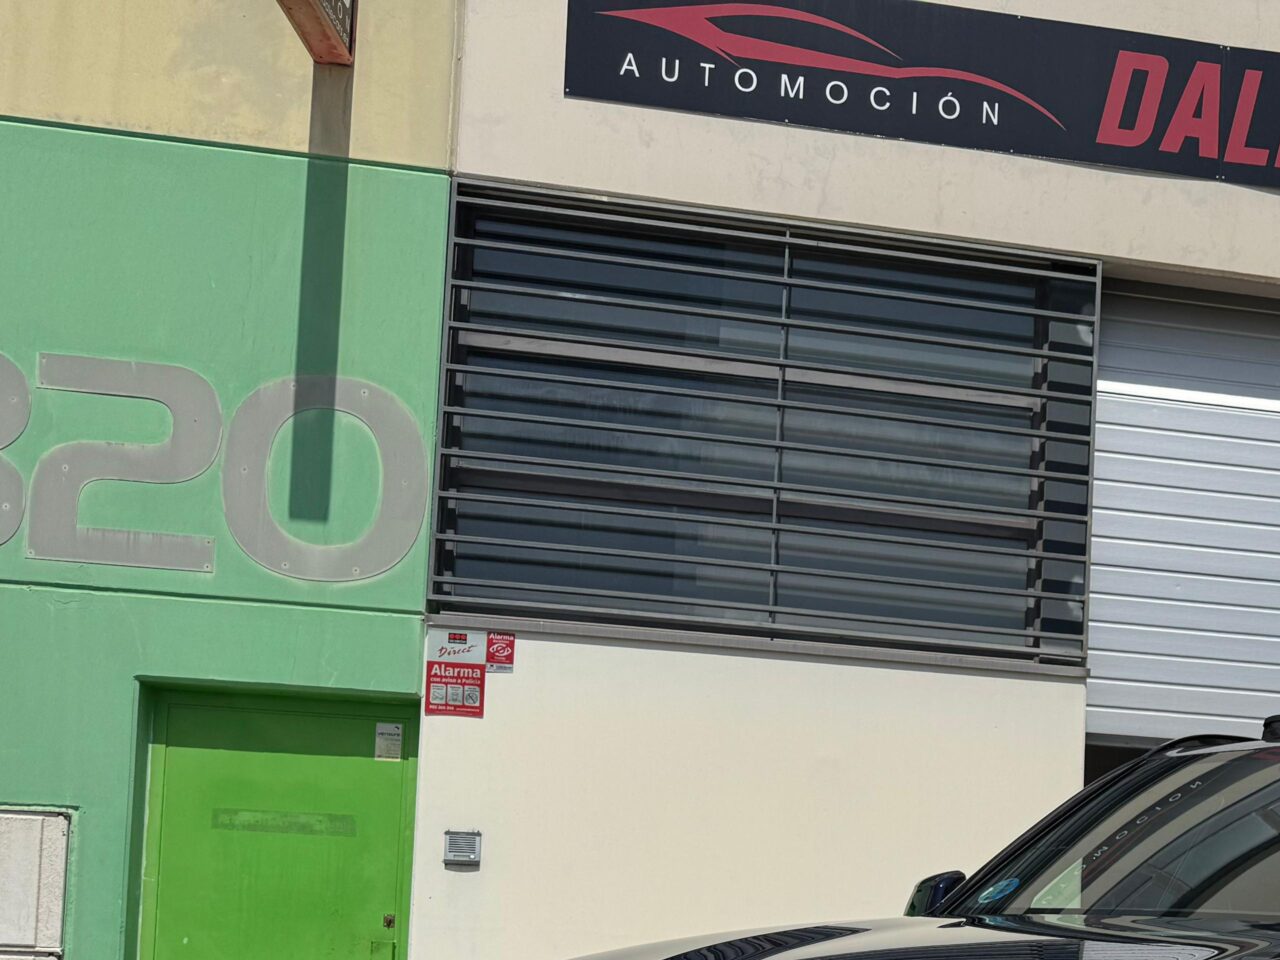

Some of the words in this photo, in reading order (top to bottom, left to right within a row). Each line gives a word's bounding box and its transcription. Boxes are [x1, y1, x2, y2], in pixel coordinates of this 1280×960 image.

[619, 52, 999, 126] AUTOMOCIÓN
[0, 351, 429, 584] 20
[431, 664, 481, 679] Alarma
